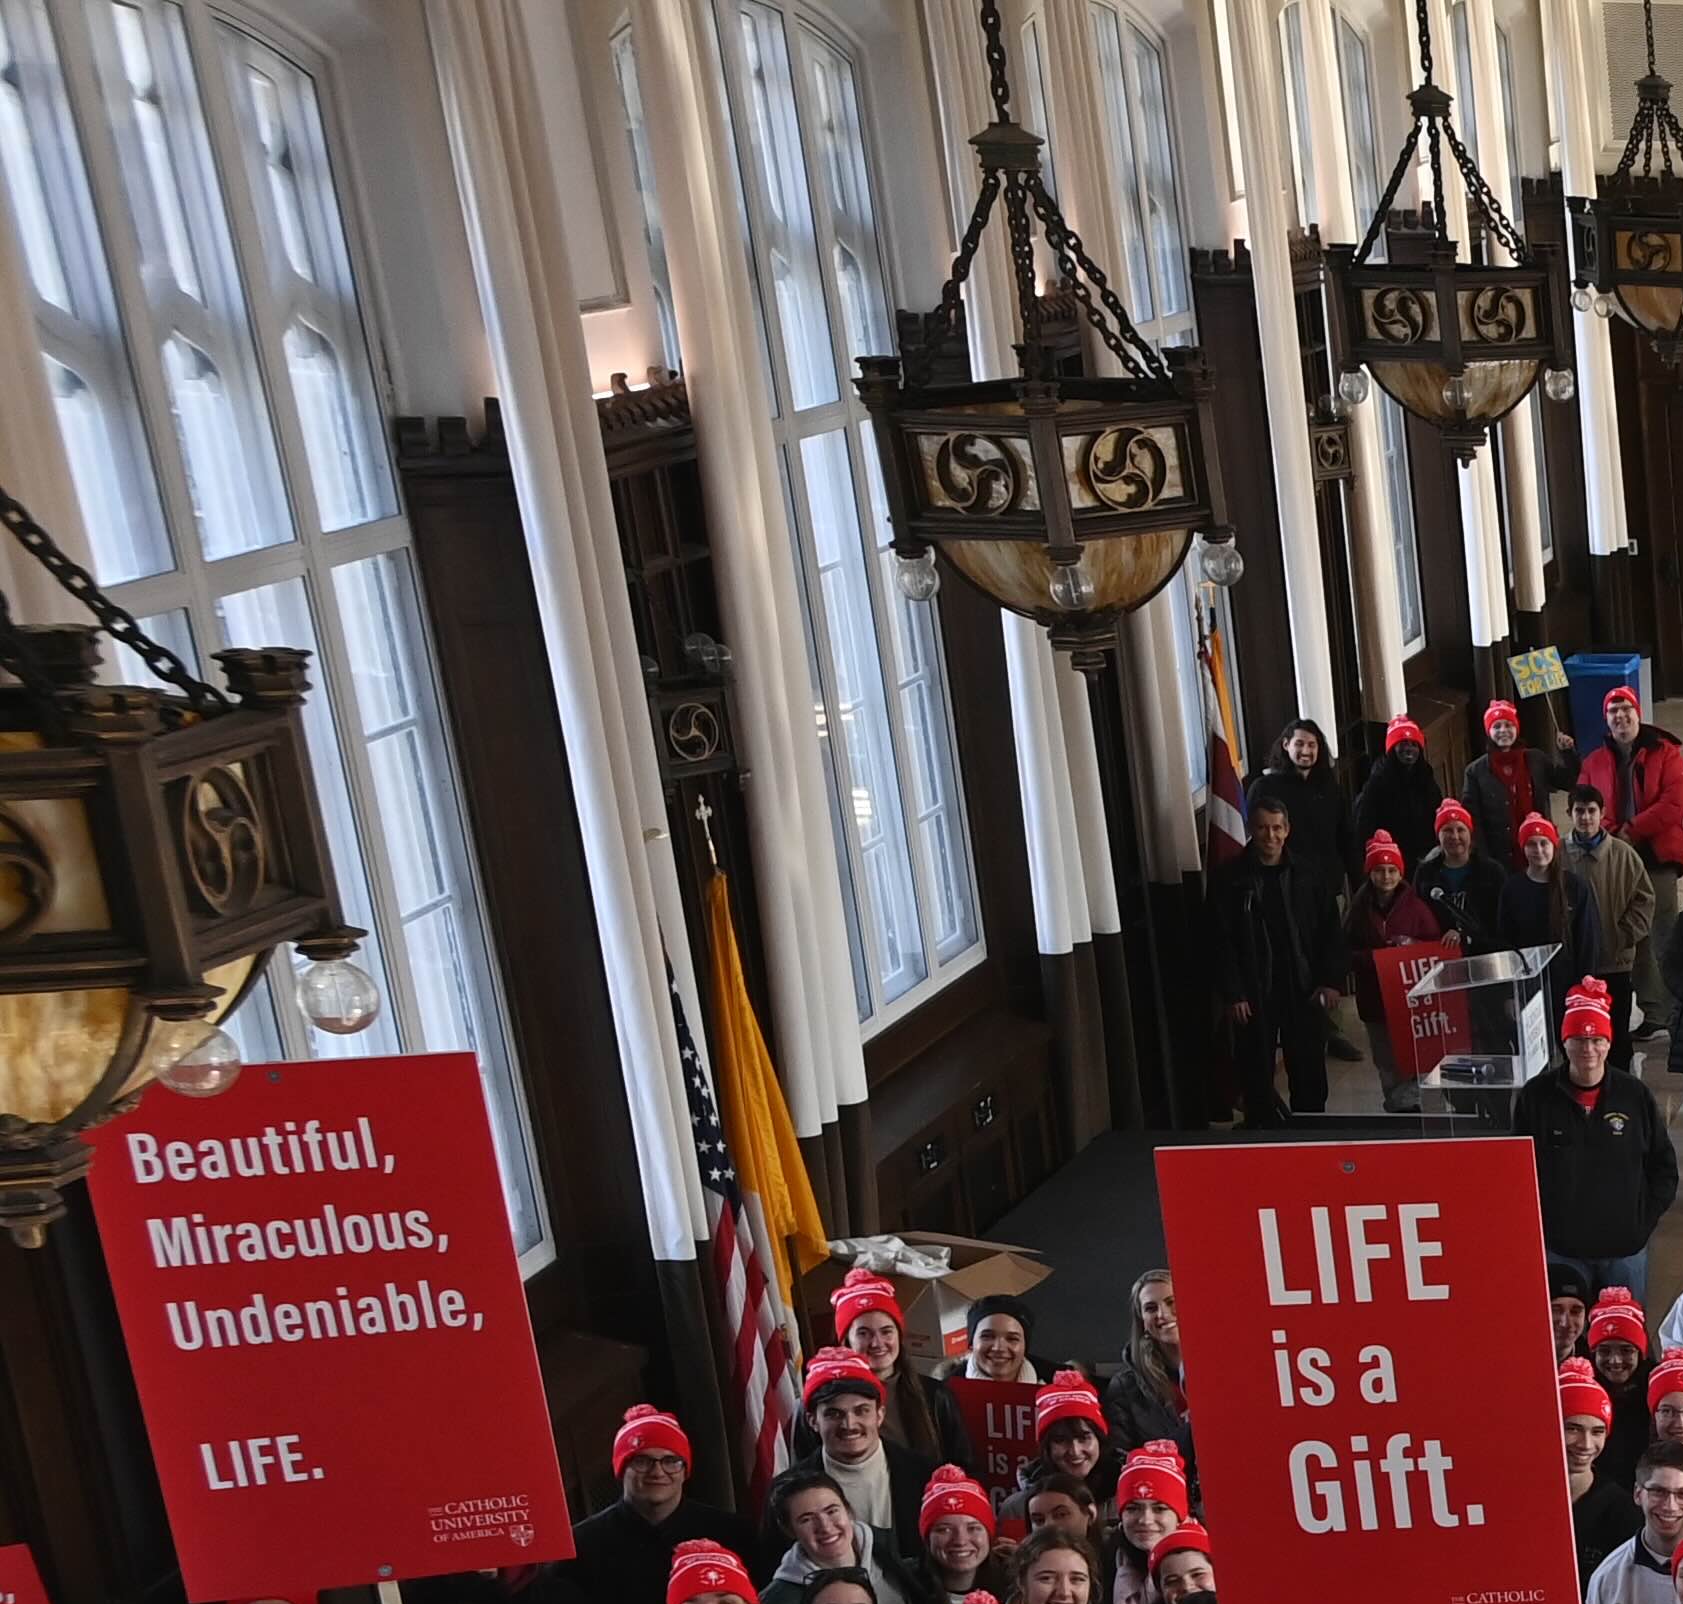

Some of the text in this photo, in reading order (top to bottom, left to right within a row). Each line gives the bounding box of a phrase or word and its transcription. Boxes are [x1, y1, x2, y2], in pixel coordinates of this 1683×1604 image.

[126, 1116, 395, 1185] Beautiful,
[146, 1204, 448, 1269] Miraculous,
[1258, 1202, 1449, 1306] LIFE
[165, 1279, 484, 1351] Undeniable,
[1271, 1329, 1398, 1407] is a
[985, 1402, 1038, 1441] LIF
[200, 1433, 325, 1491] LIFE.
[987, 1445, 1009, 1475] is
[1287, 1432, 1485, 1535] Gift.
[431, 1508, 530, 1532] UNIVERSITY
[444, 1494, 529, 1515] CATHOLIC
[433, 1527, 505, 1544] OF AMERICA
[1466, 1589, 1545, 1604] CATHOLIC
